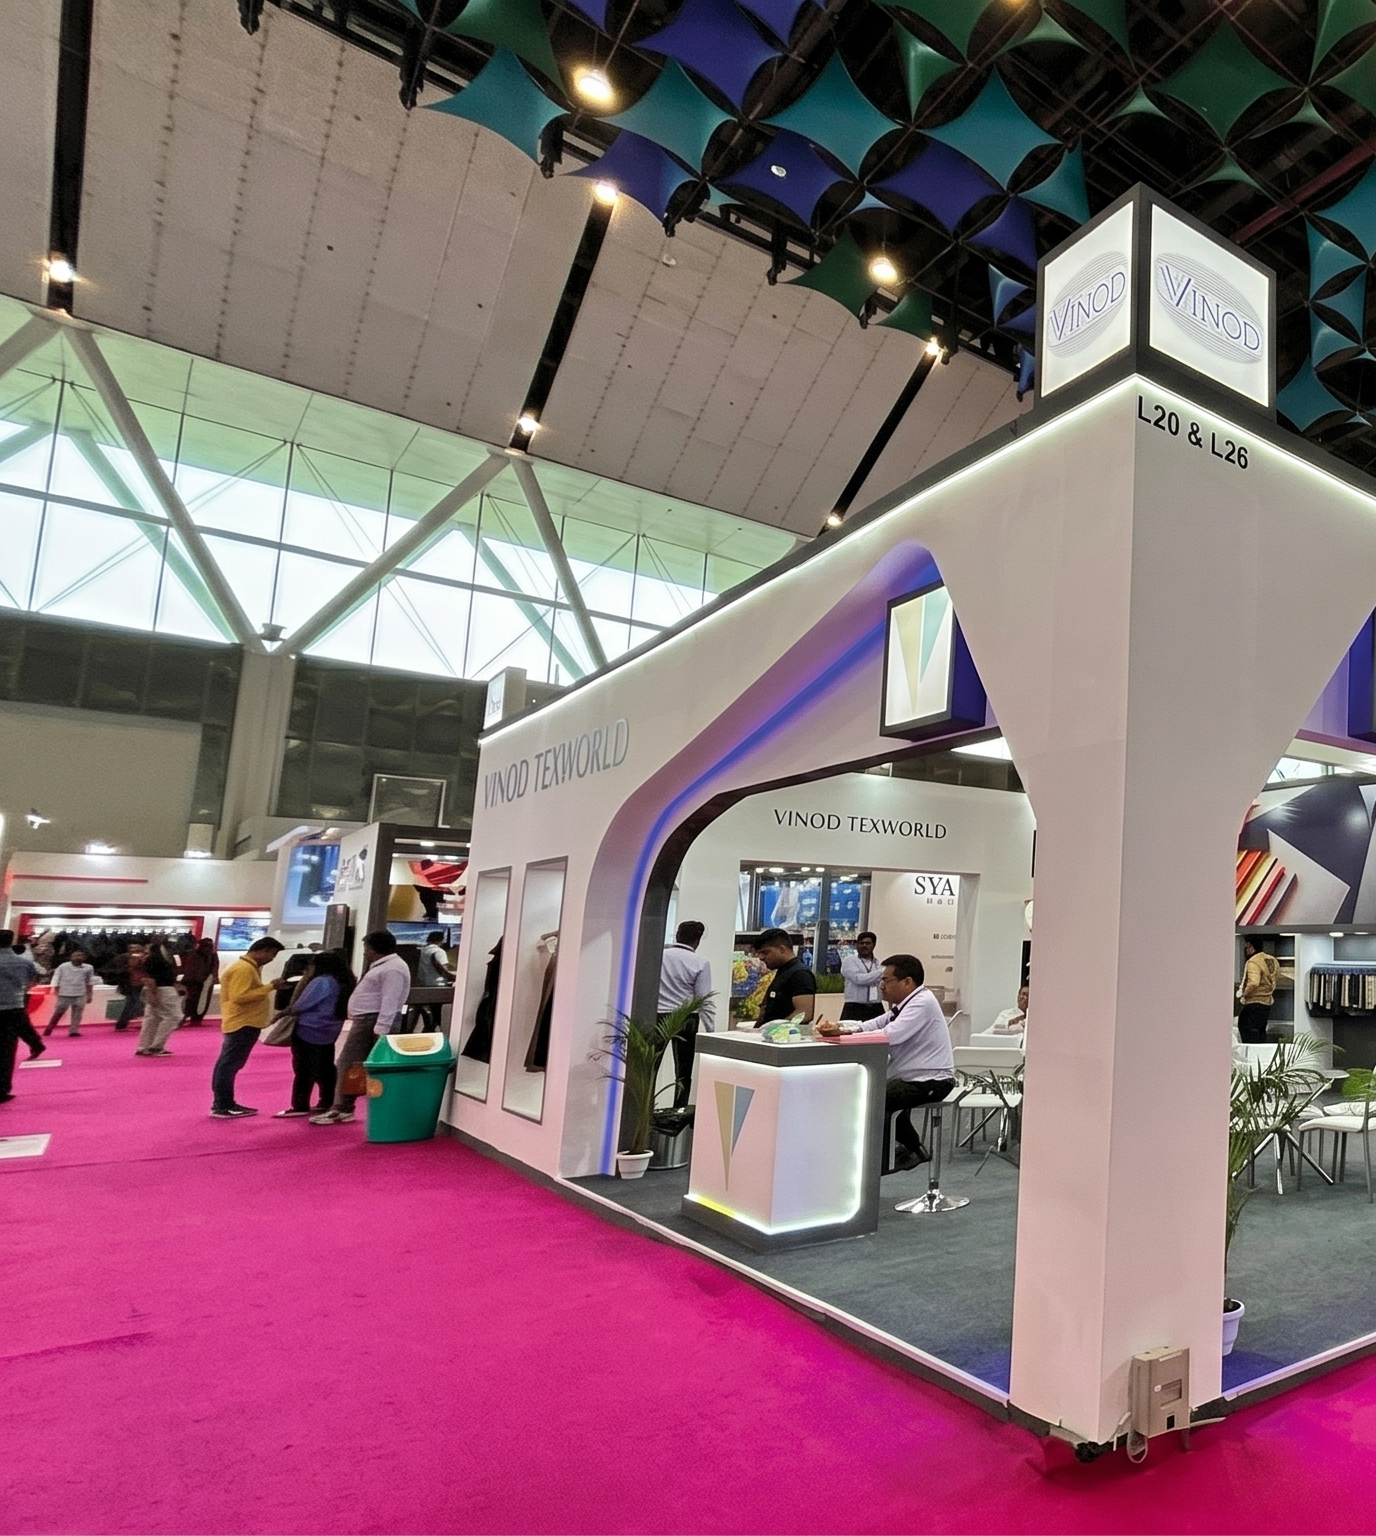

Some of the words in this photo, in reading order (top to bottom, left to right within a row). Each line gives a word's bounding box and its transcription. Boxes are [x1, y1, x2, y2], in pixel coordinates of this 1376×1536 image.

[1050, 271, 1126, 341] VINOD
[1160, 265, 1260, 351] VINOD
[1138, 395, 1180, 436] L20
[1187, 422, 1203, 449] &
[1211, 432, 1248, 469] L26
[484, 759, 529, 810] VINOD
[534, 717, 629, 793] TEXWORLD
[774, 809, 841, 831] VINOD
[847, 816, 947, 839] TEXWORLD
[914, 875, 956, 897] SYA
